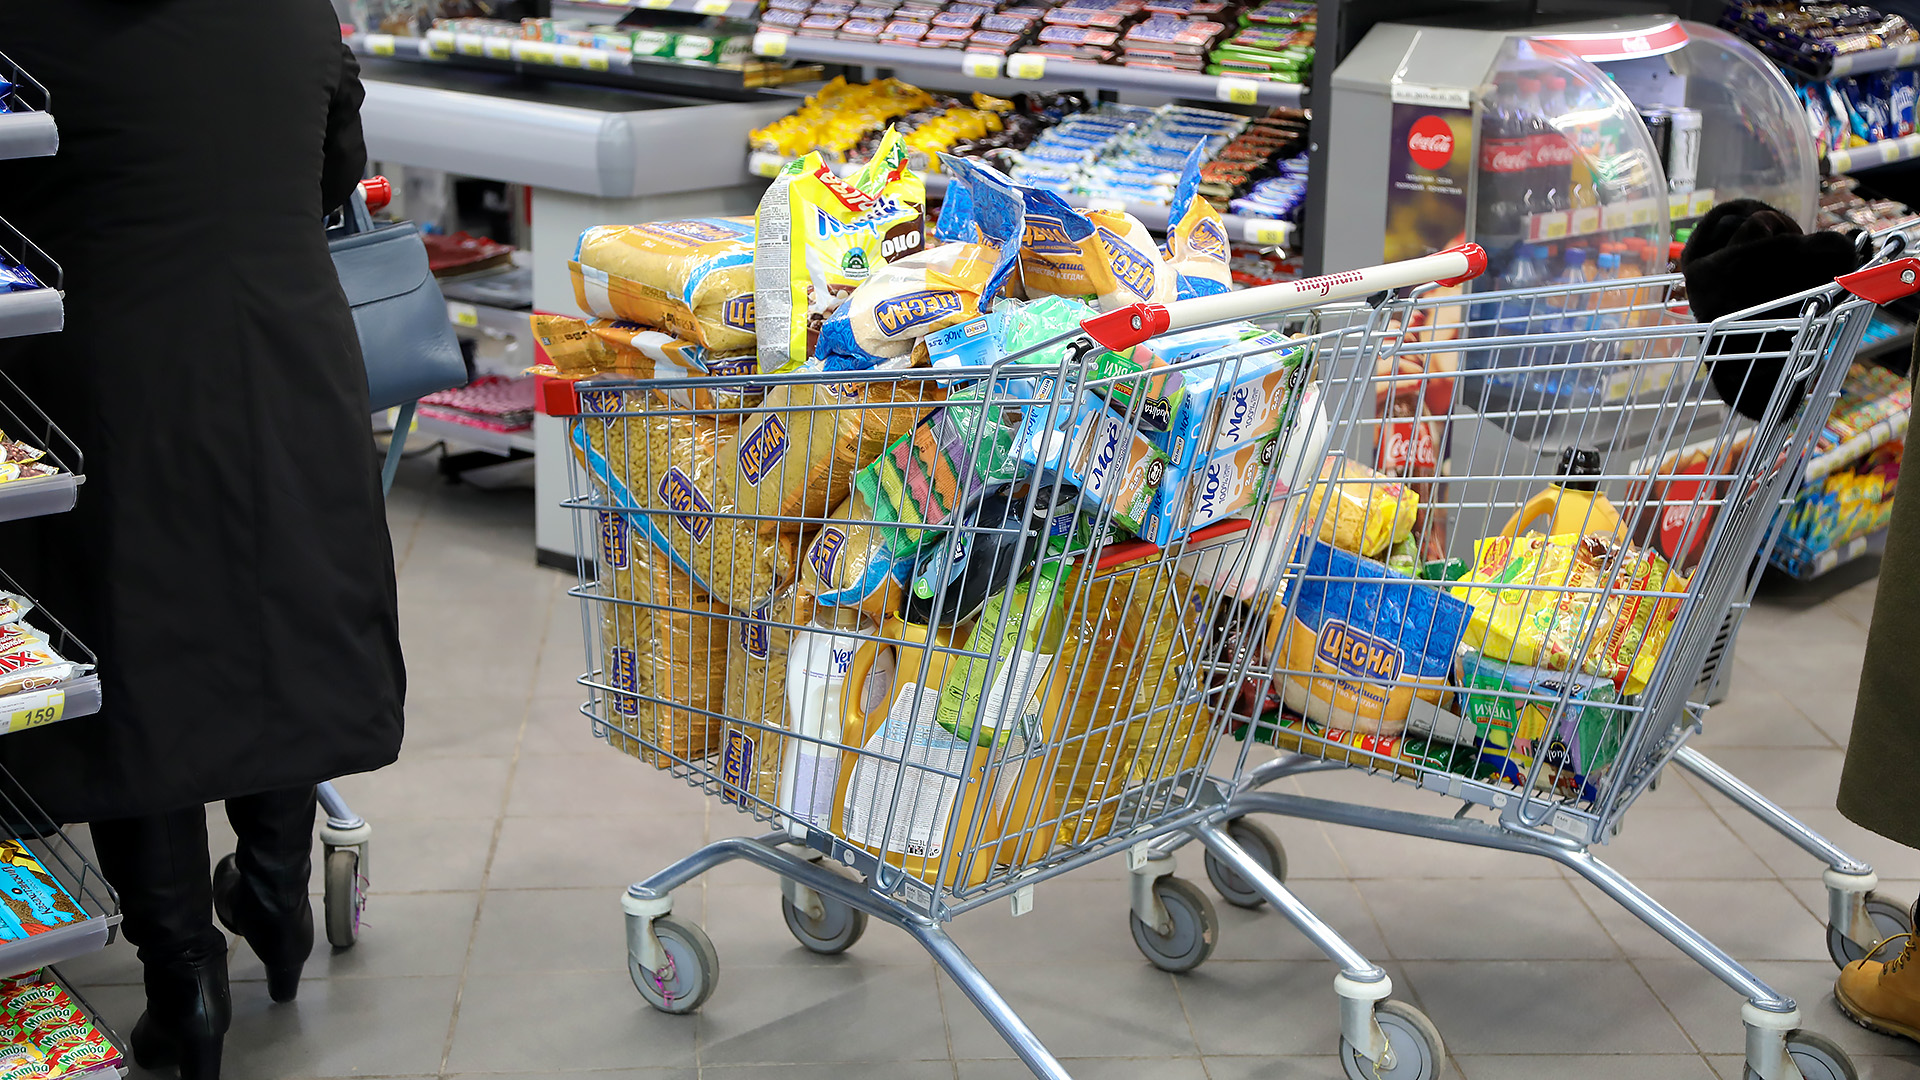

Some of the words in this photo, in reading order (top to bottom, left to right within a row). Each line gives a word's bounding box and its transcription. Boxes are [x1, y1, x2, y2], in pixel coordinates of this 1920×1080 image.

[881, 231, 921, 257] DUO
[1227, 386, 1249, 442] Моё
[740, 421, 785, 478] ЦЕСНА
[1094, 421, 1121, 490] Моё
[604, 512, 623, 564] ЦЕСН
[1323, 627, 1395, 679] ЦЕСНА
[616, 651, 636, 712] ЦСНА
[1316, 679, 1350, 699] КАЧЕТВО.
[24, 706, 55, 728] 159
[7, 988, 56, 1011] Mamba
[23, 1007, 70, 1031] Mamba
[41, 1026, 88, 1048] Mamba
[59, 1043, 105, 1067] Mamba
